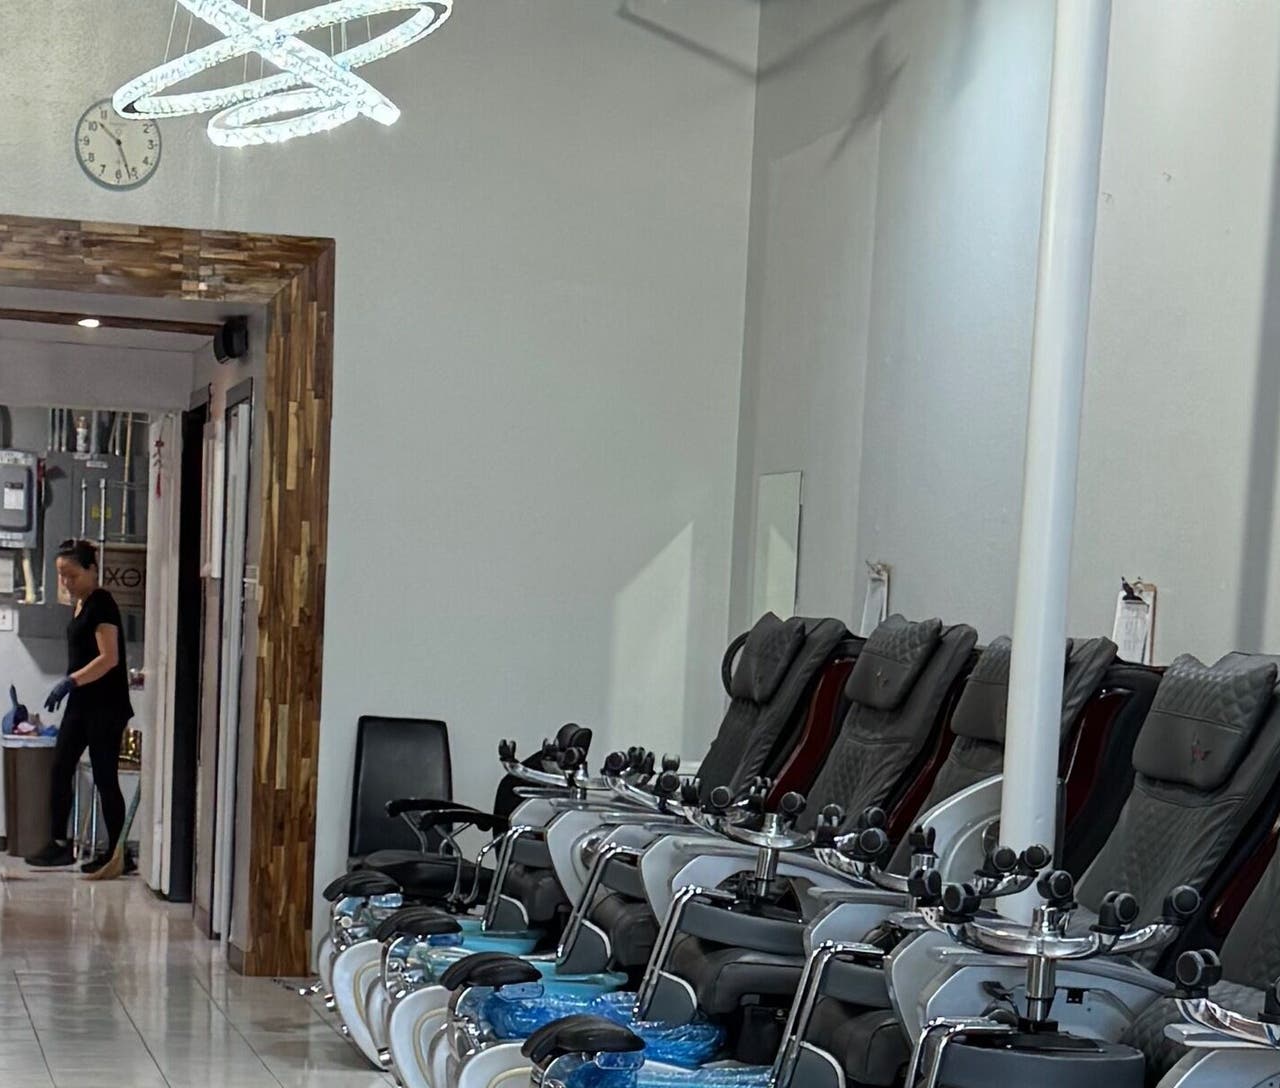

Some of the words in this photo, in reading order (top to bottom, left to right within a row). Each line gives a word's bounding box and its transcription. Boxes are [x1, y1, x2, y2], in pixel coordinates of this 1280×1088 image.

[88, 121, 97, 131] 10
[143, 124, 150, 134] 2
[83, 136, 90, 146] 9
[147, 140, 154, 150] 3
[100, 164, 106, 174] 7
[115, 169, 122, 179] 6
